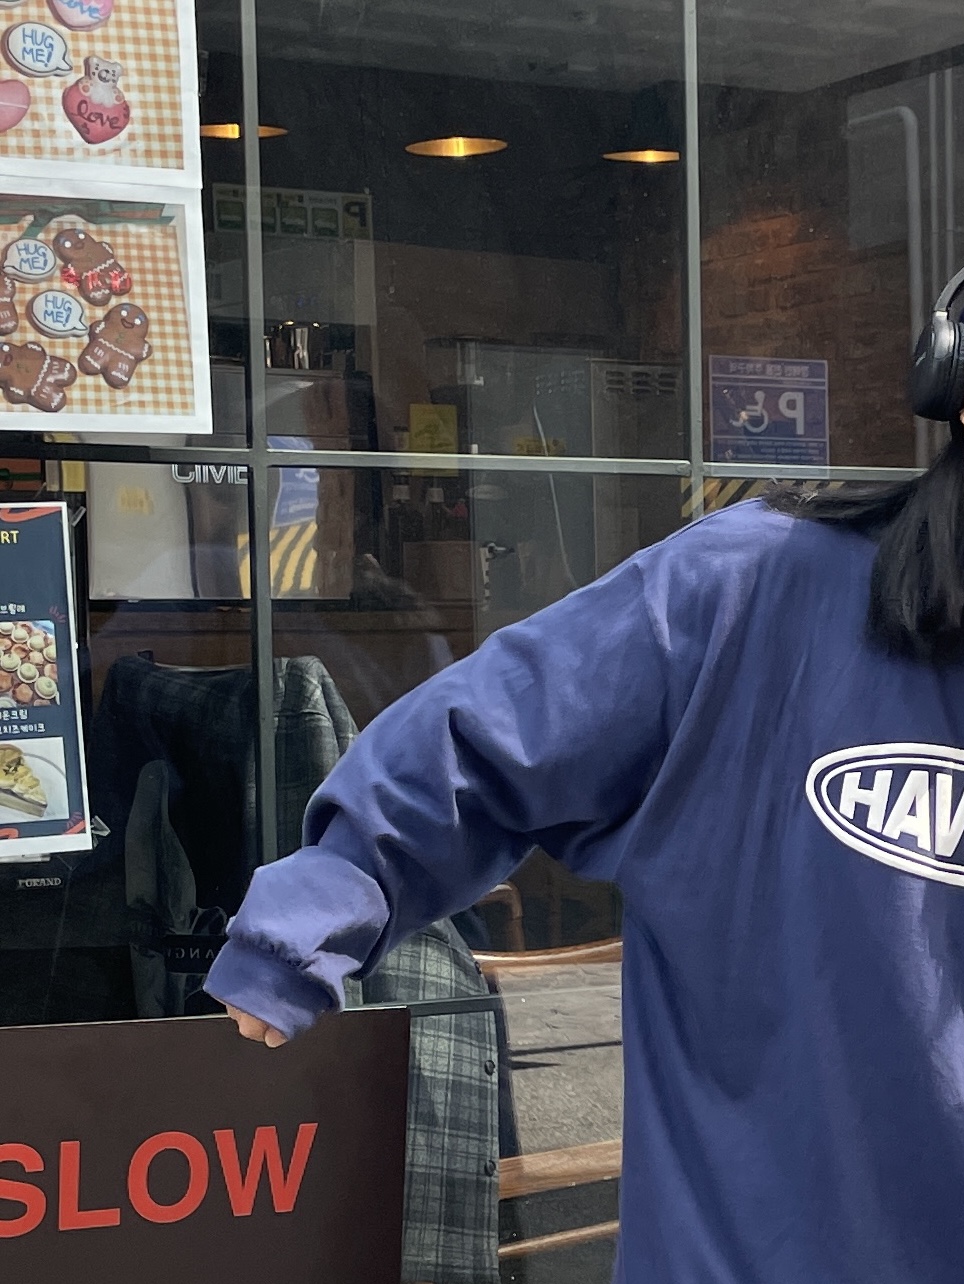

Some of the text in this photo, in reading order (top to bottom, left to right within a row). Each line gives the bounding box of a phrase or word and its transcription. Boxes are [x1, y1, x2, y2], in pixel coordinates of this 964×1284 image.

[22, 28, 54, 51] HUG
[22, 47, 53, 67] ME!
[16, 243, 47, 258] HUG
[20, 257, 48, 270] ME!
[45, 294, 72, 313] HUG
[43, 310, 71, 327] ME!
[0, 1122, 319, 1238] SLOW
